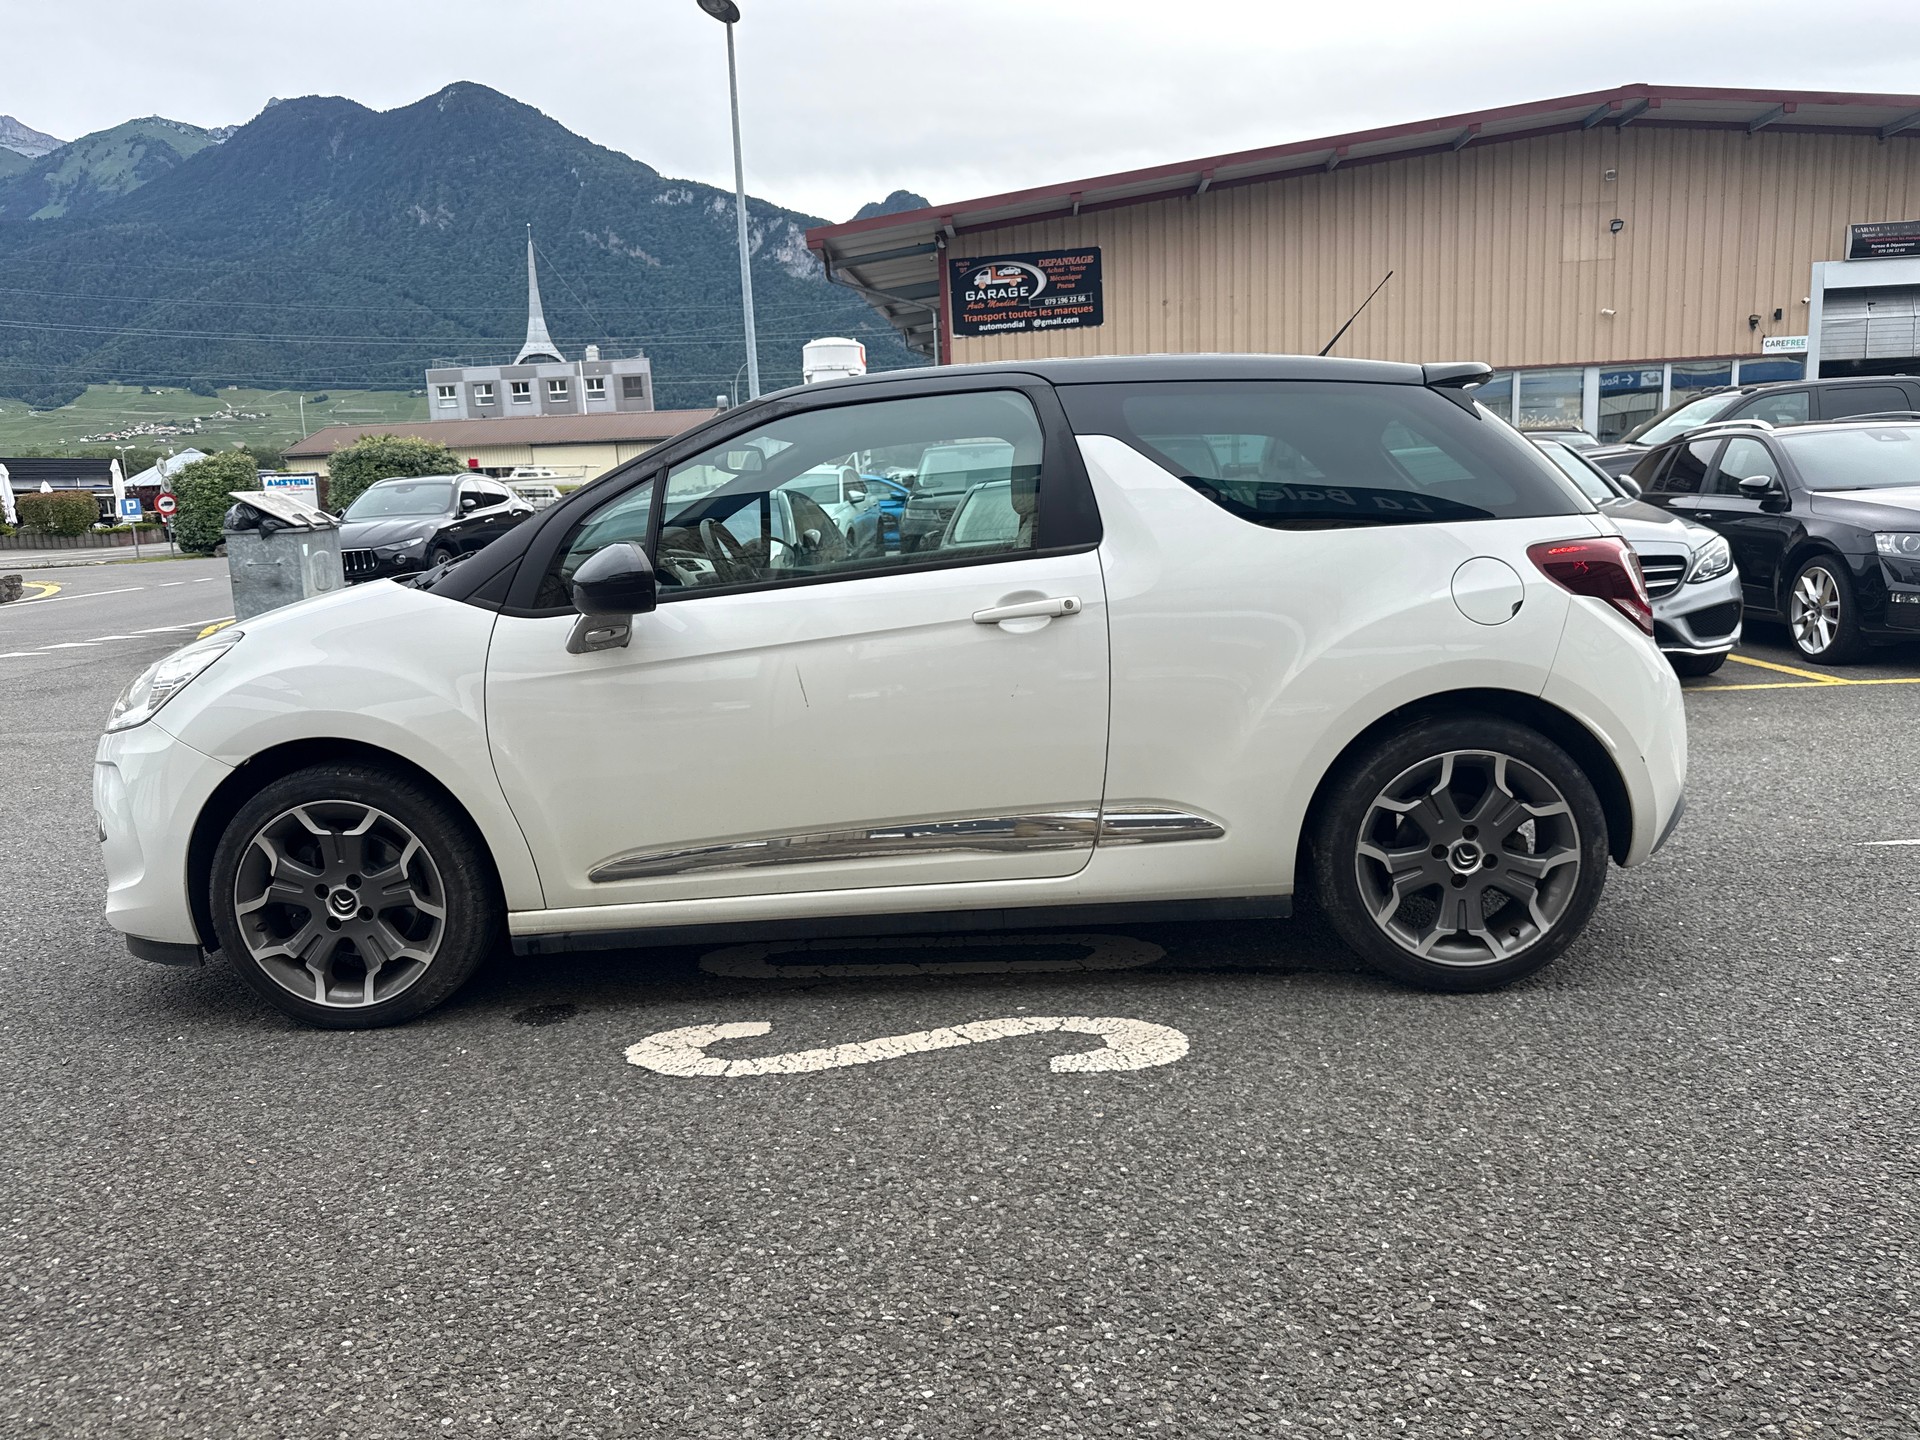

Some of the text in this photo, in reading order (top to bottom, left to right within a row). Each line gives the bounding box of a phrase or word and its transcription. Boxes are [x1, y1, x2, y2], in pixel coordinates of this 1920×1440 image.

[1038, 255, 1094, 267] DEPANNAGE
[965, 286, 1029, 301] GARAGE
[967, 298, 1018, 310] Auto Mondial
[963, 304, 1094, 323] Transport toutes les marques
[978, 317, 1079, 331] automondial @gmail.com
[1765, 339, 1806, 347] CAREFREE
[266, 478, 310, 487] AMSTEIN
[125, 500, 137, 514] P
